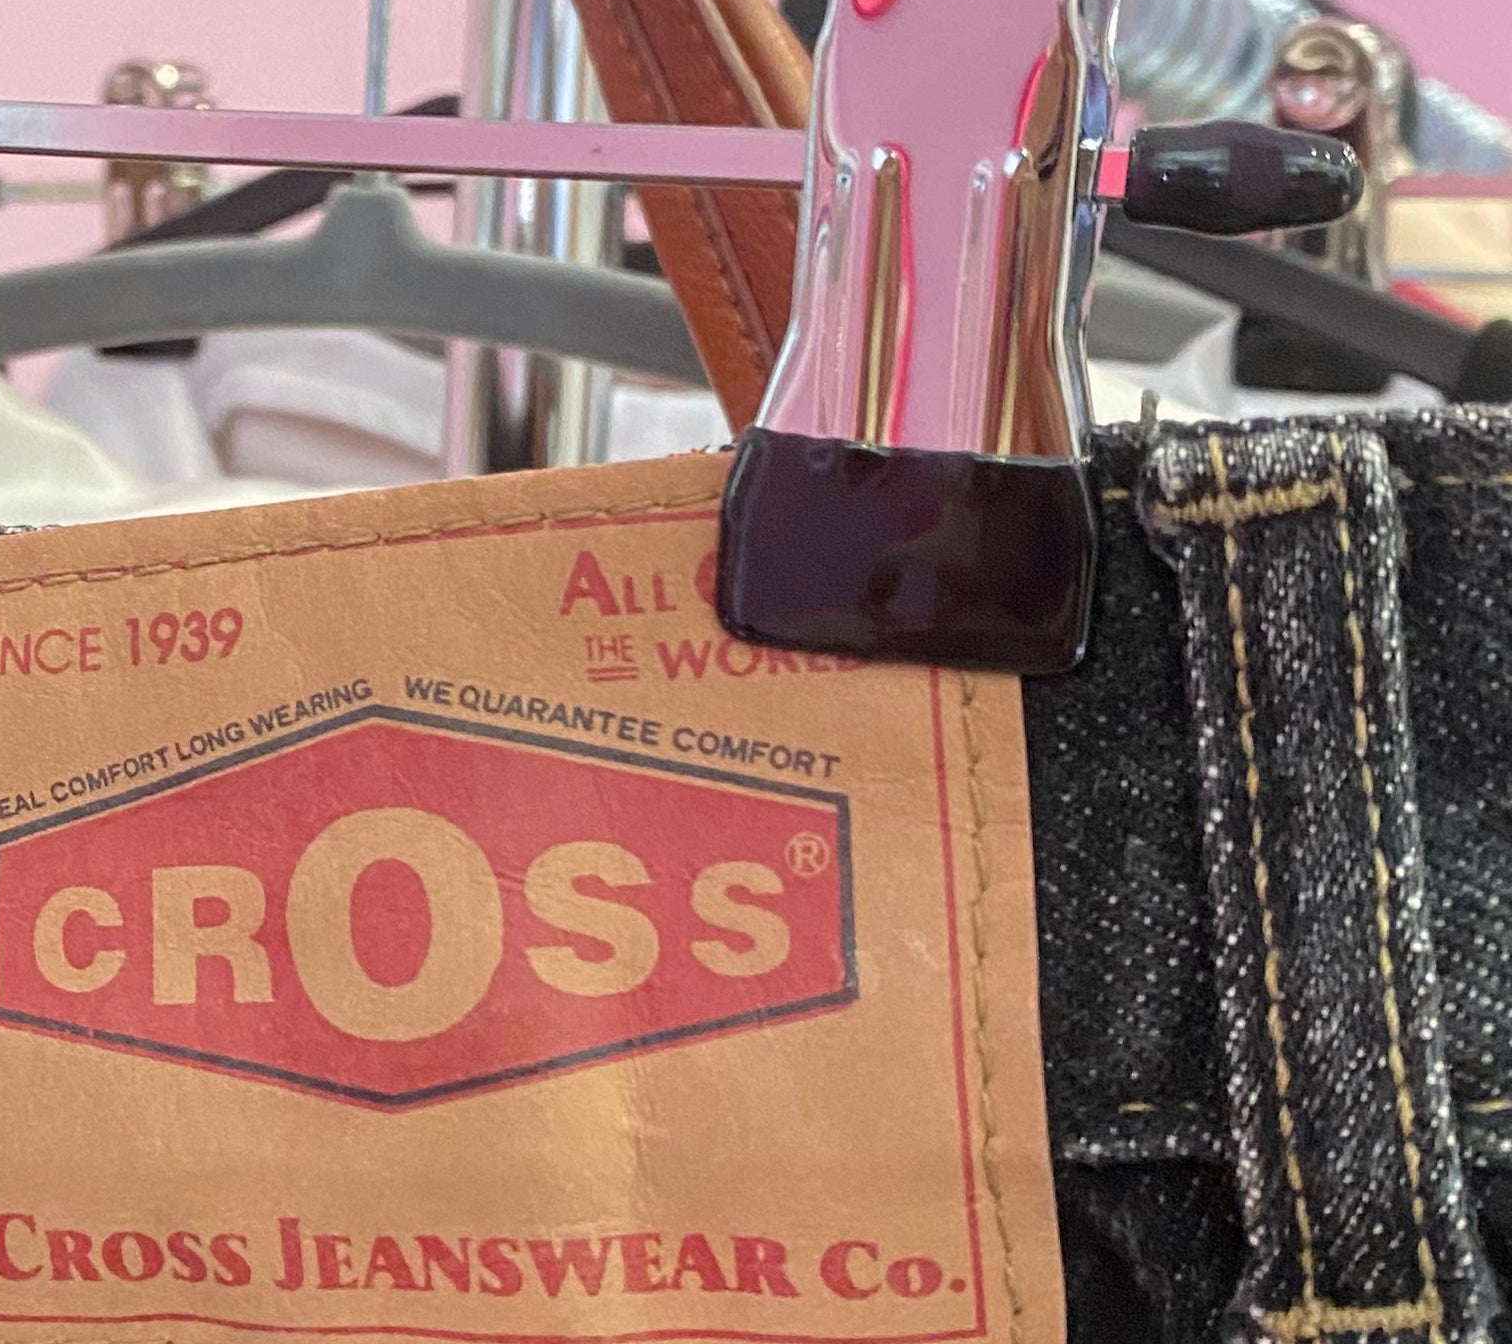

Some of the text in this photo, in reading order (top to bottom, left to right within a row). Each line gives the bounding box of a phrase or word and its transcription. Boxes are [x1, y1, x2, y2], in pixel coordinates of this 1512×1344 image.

[560, 550, 677, 616] ALL
[126, 608, 244, 667] 1939
[584, 634, 634, 662] THE
[50, 746, 170, 802] COMFORT
[174, 722, 245, 761] LONG
[247, 678, 374, 738] WEARING
[404, 675, 841, 779] WE QUARANTEE COMFORT
[32, 806, 791, 1042] CROSS
[273, 1216, 801, 1299] JEANSWEAR
